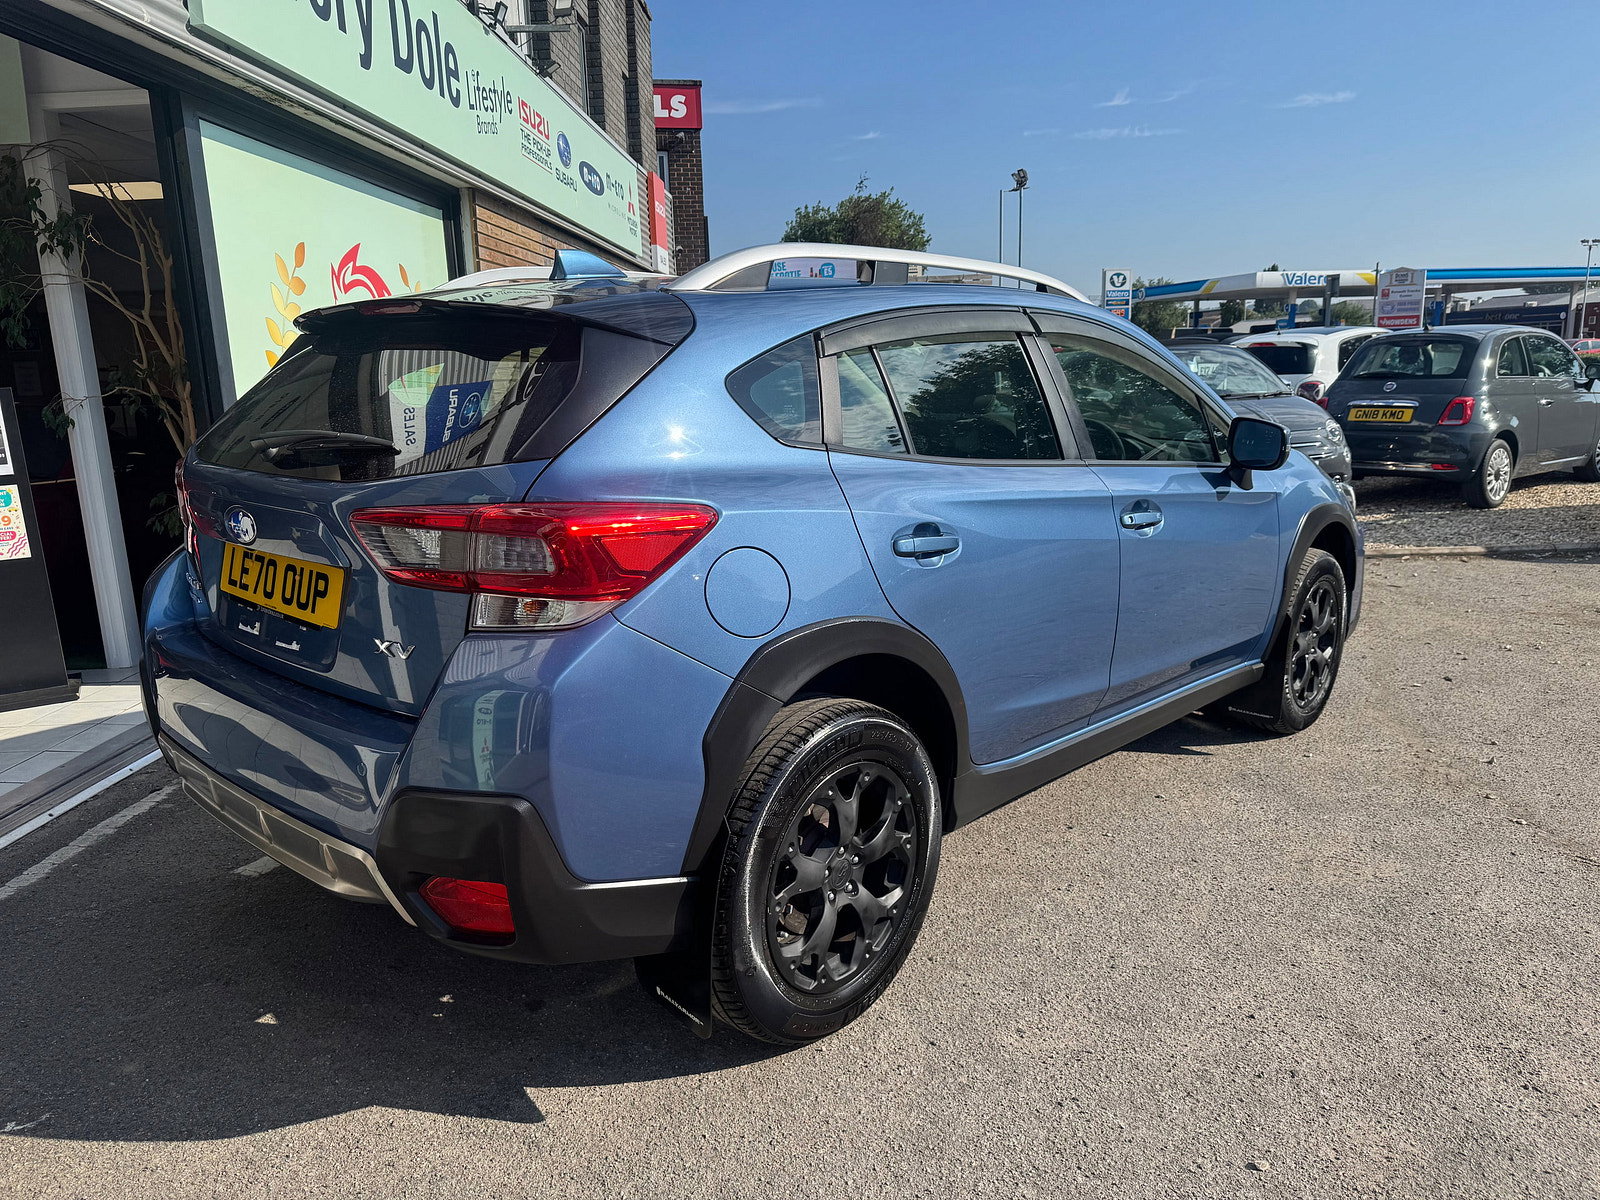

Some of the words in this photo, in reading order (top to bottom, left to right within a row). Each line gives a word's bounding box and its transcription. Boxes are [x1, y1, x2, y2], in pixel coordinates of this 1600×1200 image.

[388, 0, 461, 109] Dole
[466, 69, 513, 124] Lifestyle
[653, 94, 688, 119] LS
[476, 114, 499, 135] Brands
[517, 95, 550, 141] ISUZU
[520, 128, 531, 145] THE
[532, 136, 551, 159] PICK-UP
[555, 167, 578, 193] SUBARU
[1354, 409, 1380, 419] GN18
[1381, 409, 1405, 420] KMO
[228, 546, 277, 600] LE70
[281, 563, 329, 614] OUP
[373, 637, 416, 660] XV
